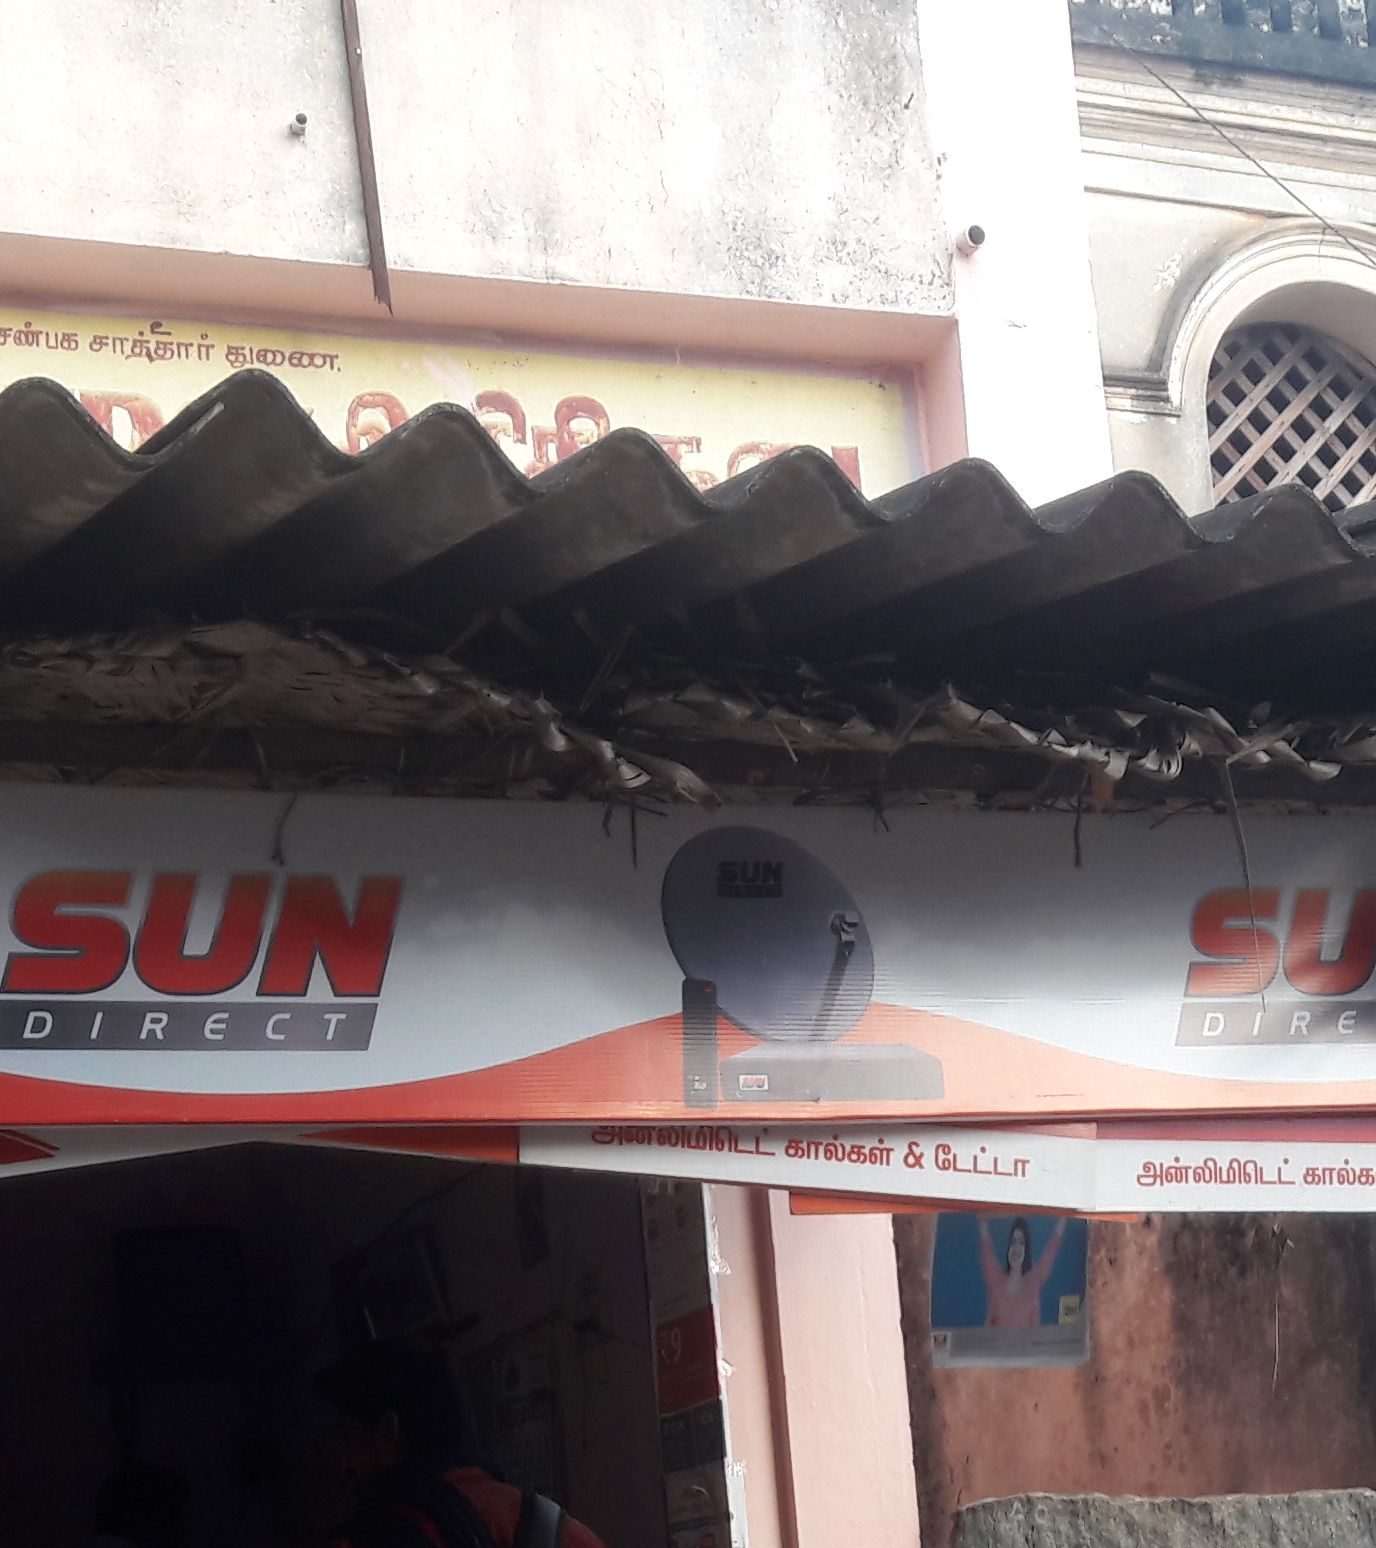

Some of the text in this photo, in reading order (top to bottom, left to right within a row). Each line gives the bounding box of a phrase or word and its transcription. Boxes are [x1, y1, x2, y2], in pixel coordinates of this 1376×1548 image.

[0, 869, 403, 997] SUN
[23, 1012, 348, 1041] DIRECT
[785, 1135, 895, 1168] கால்கள்
[903, 1142, 925, 1170] &
[934, 1142, 1030, 1179] டேட்டா
[1136, 1157, 1296, 1188] அன்லிமிடெட்
